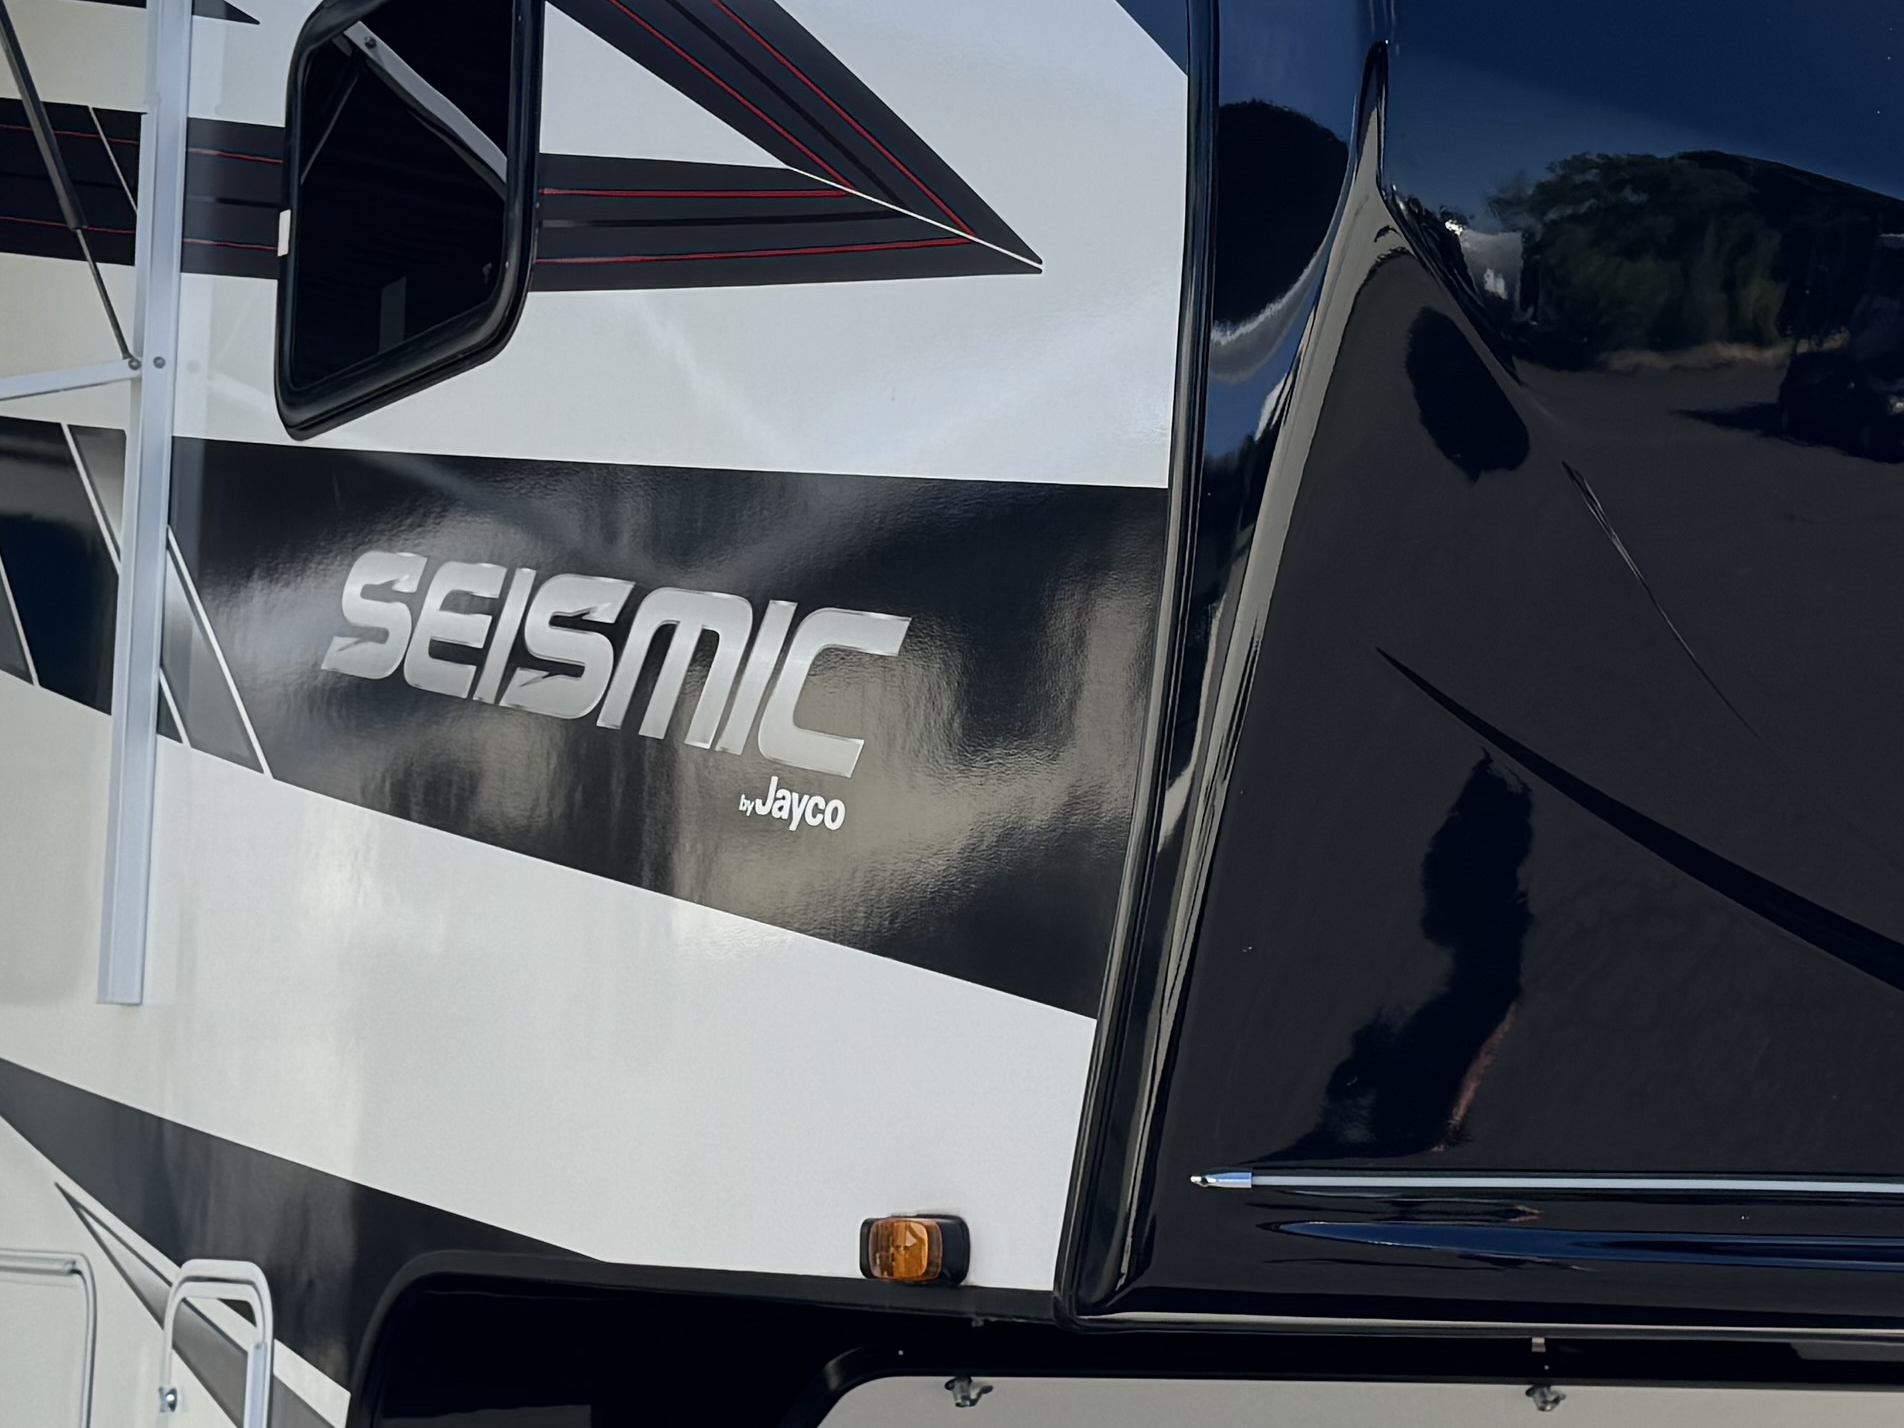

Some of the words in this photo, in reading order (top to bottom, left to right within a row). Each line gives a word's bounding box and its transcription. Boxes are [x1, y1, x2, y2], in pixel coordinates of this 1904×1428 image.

[321, 550, 913, 778] SEISMIC
[738, 793, 755, 817] by
[754, 775, 846, 832] Jayco
